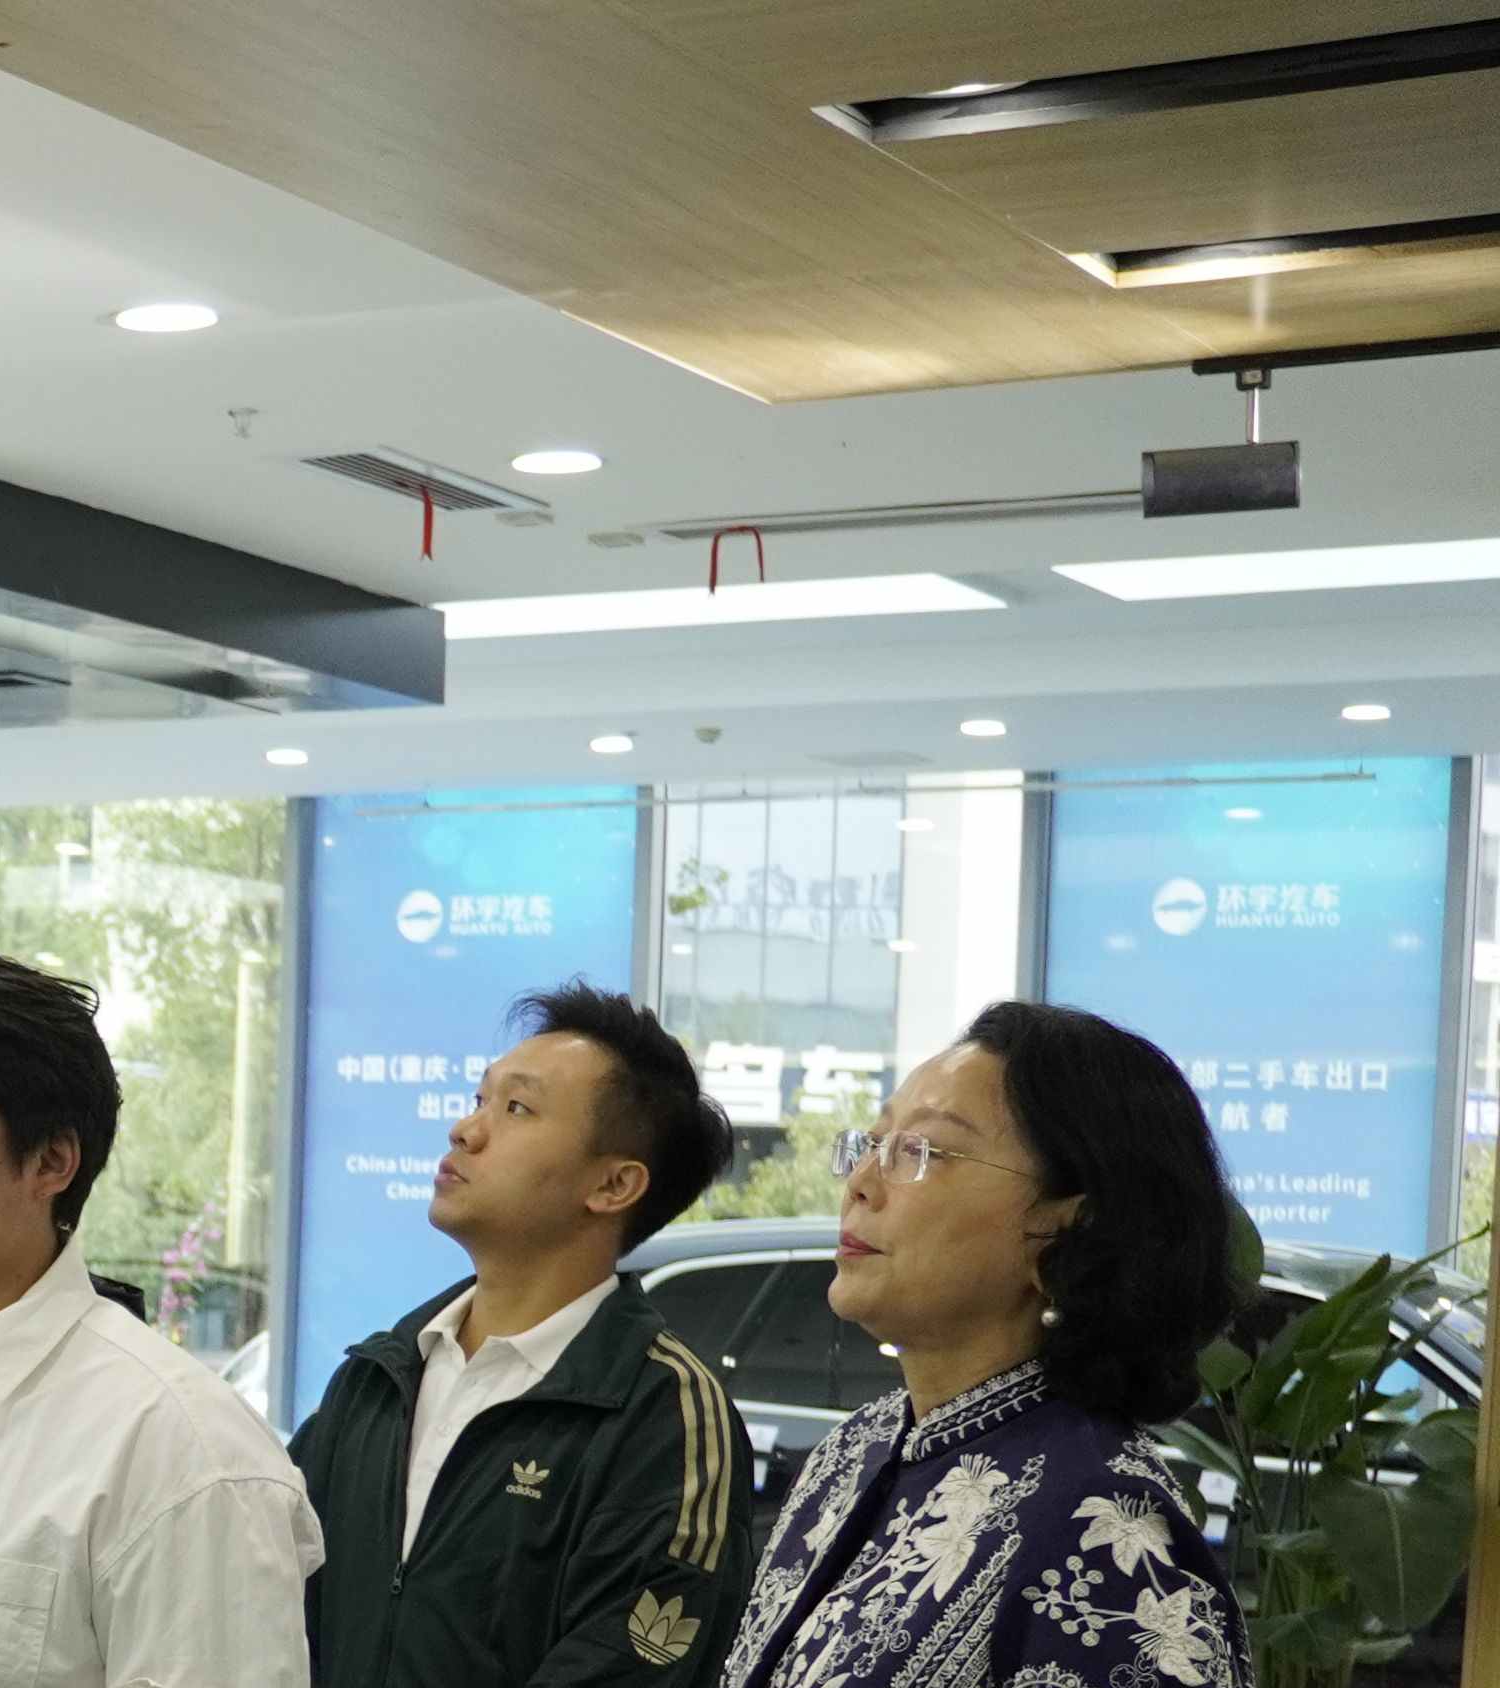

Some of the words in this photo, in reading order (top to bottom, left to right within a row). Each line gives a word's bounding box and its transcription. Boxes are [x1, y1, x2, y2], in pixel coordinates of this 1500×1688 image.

[1216, 883, 1342, 914] 环宇汽车
[336, 1054, 496, 1084] 中国(重庆·巴
[1182, 1058, 1389, 1091] 部二手车出口
[417, 1092, 476, 1120] 出口
[1204, 1101, 1291, 1132] 航者
[345, 1155, 398, 1174] China
[1279, 1172, 1371, 1199] Leading
